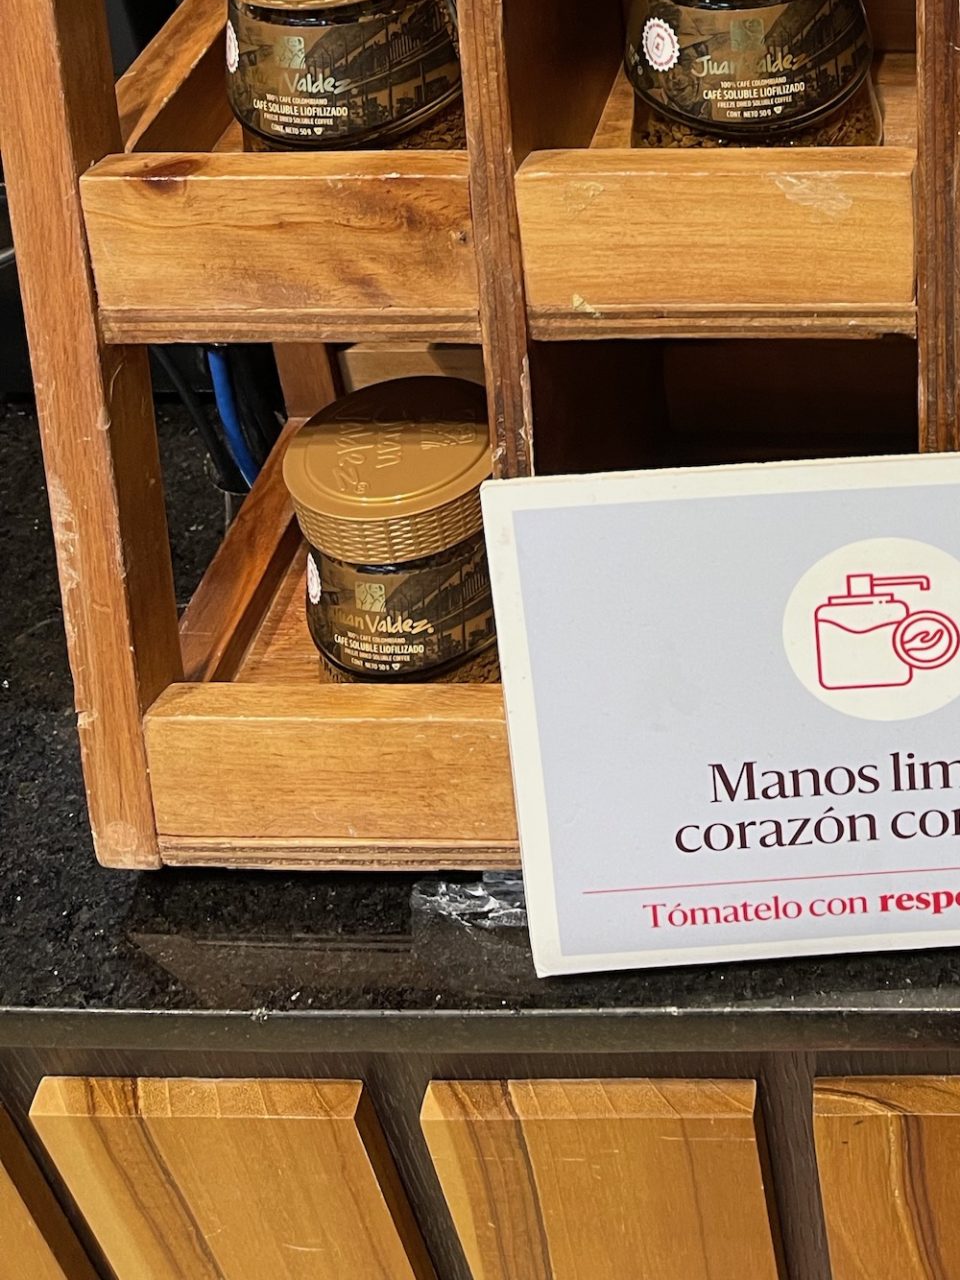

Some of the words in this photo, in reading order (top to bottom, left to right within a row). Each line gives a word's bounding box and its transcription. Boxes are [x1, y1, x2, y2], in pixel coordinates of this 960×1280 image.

[284, 72, 351, 95] Valdez
[703, 88, 722, 100] CAFÉ
[724, 89, 758, 100] SOLUBLE
[760, 82, 805, 98] LIOFILIZADO
[268, 102, 299, 116] SOLUBLE
[300, 106, 348, 117] LIOFILIZADO
[365, 614, 432, 635] Valdez
[349, 639, 378, 653] SOLUBLE
[379, 644, 424, 654] LIOFILIZADO
[708, 760, 881, 804] Manos
[674, 807, 880, 854] corazón
[643, 895, 803, 930] Tómatelo
[808, 897, 868, 918] con
